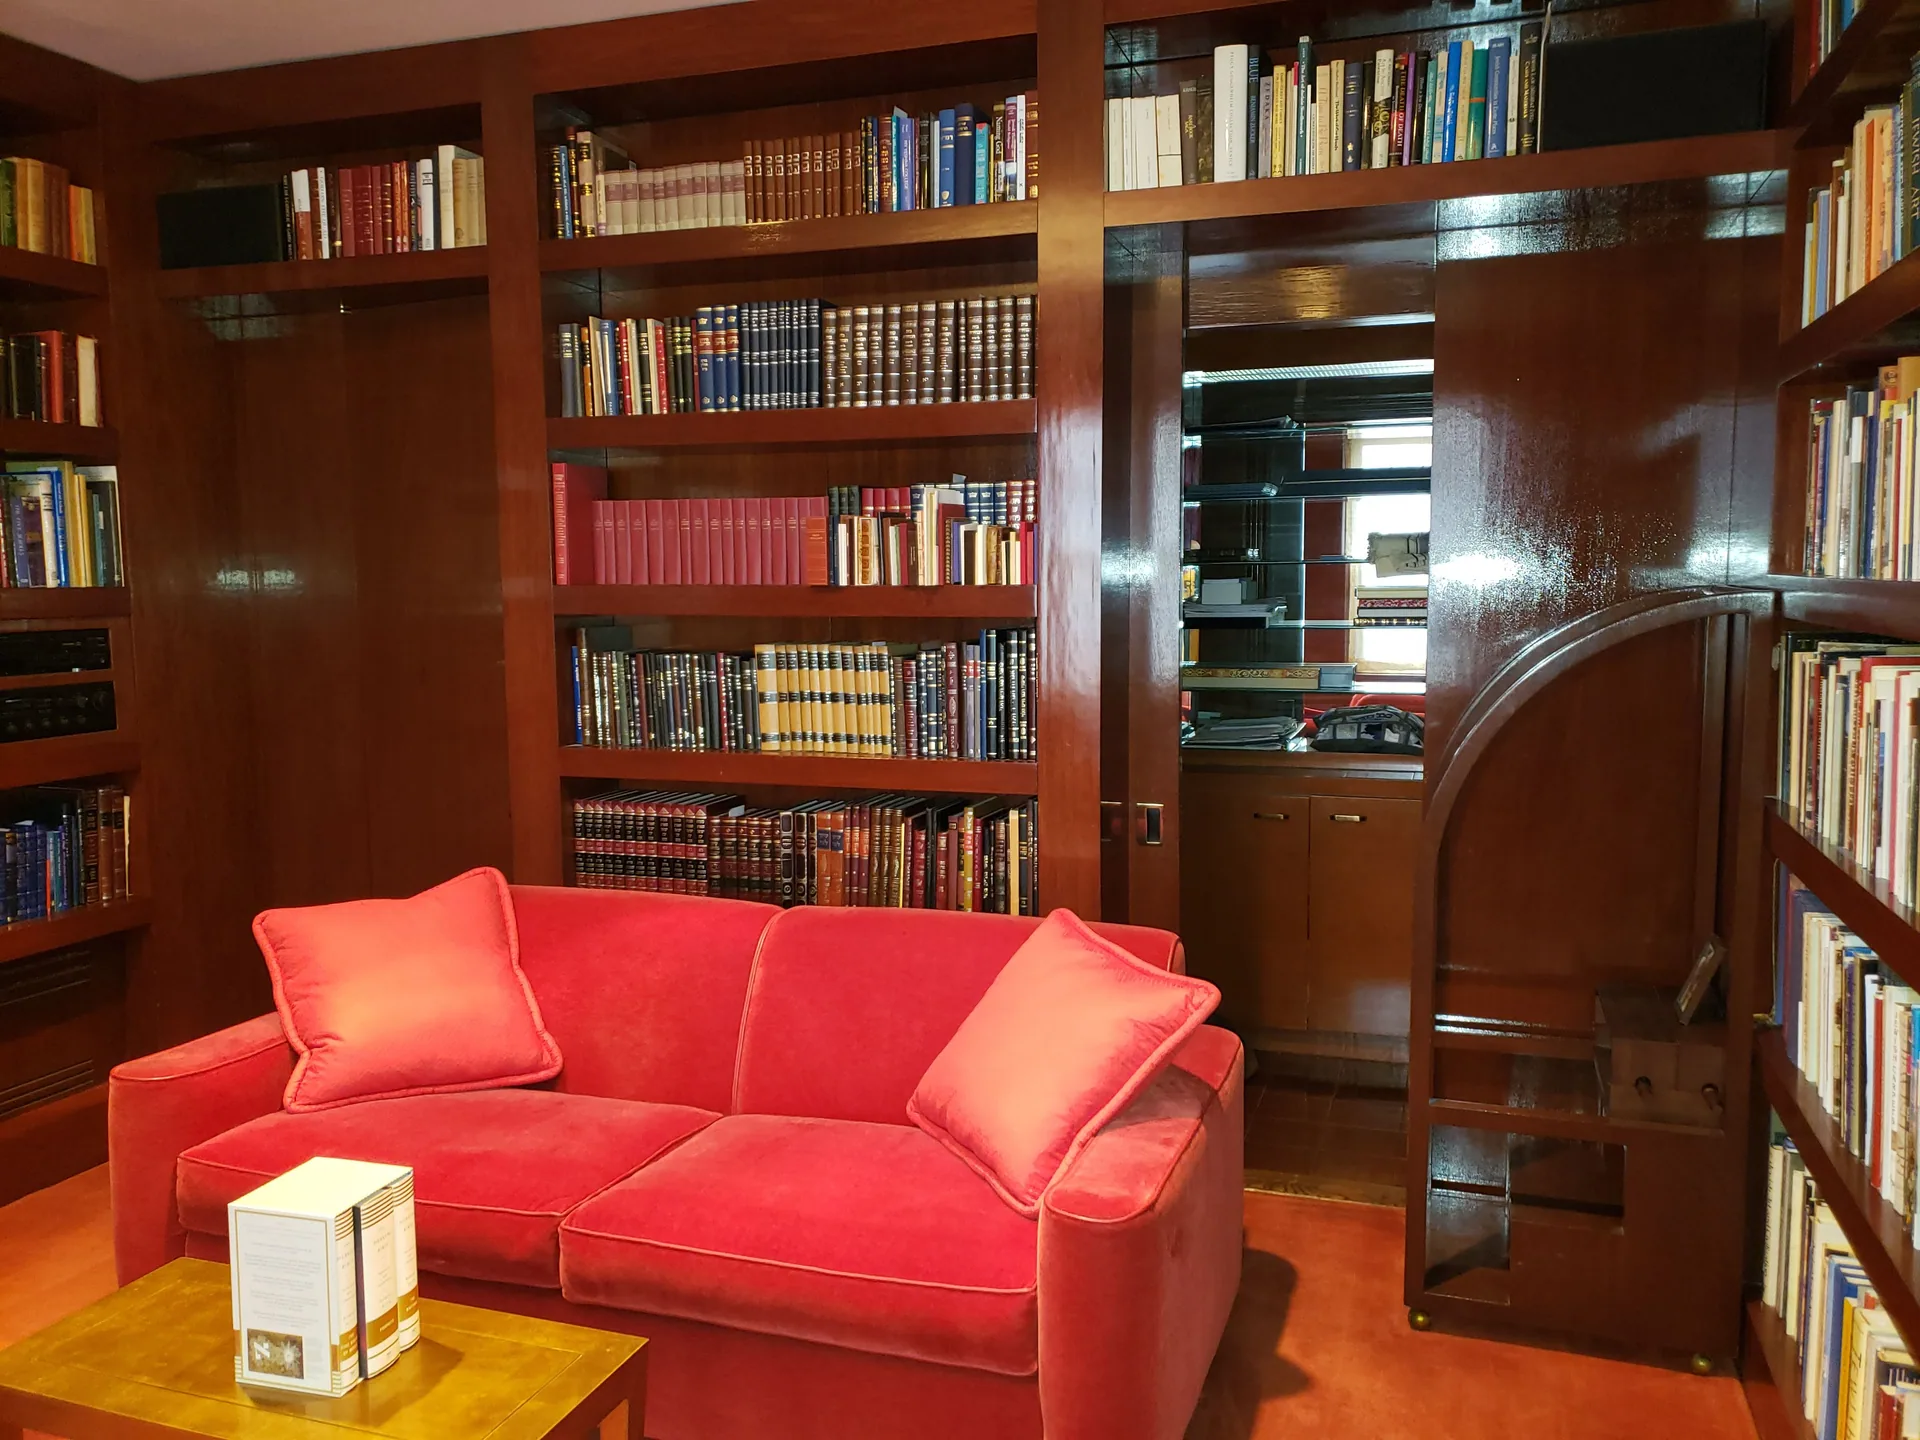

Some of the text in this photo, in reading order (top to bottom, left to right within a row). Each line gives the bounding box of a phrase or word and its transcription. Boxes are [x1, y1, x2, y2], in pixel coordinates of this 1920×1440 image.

[1249, 57, 1259, 84] BLUE
[994, 116, 1003, 140] Naming
[1398, 112, 1405, 122] OF
[1911, 117, 1920, 219] JEWISH ART
